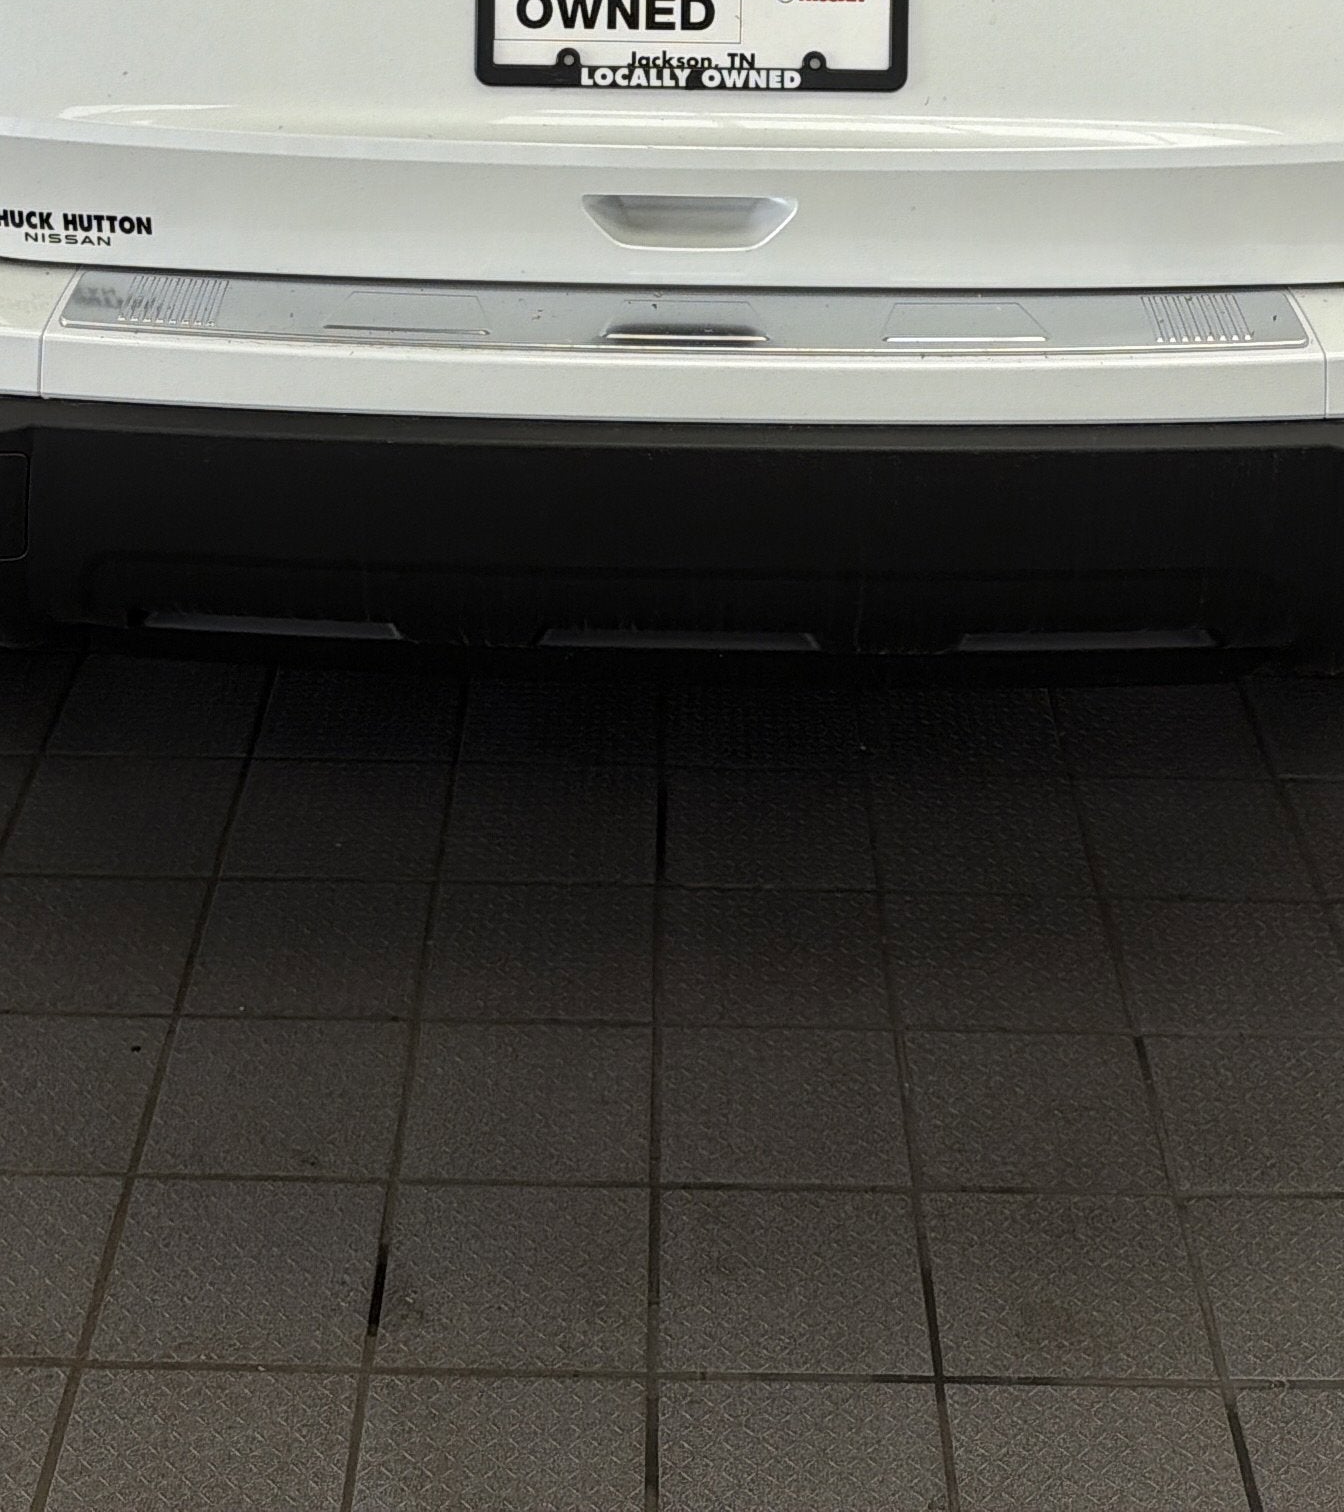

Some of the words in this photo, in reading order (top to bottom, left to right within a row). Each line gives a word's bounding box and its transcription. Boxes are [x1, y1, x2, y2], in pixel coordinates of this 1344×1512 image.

[627, 50, 719, 69] Jackson,
[727, 52, 756, 69] TN
[580, 67, 692, 87] LOCALLY
[701, 68, 802, 89] OWNED
[62, 212, 153, 236] HUTTON
[24, 231, 112, 247] NISSAN
